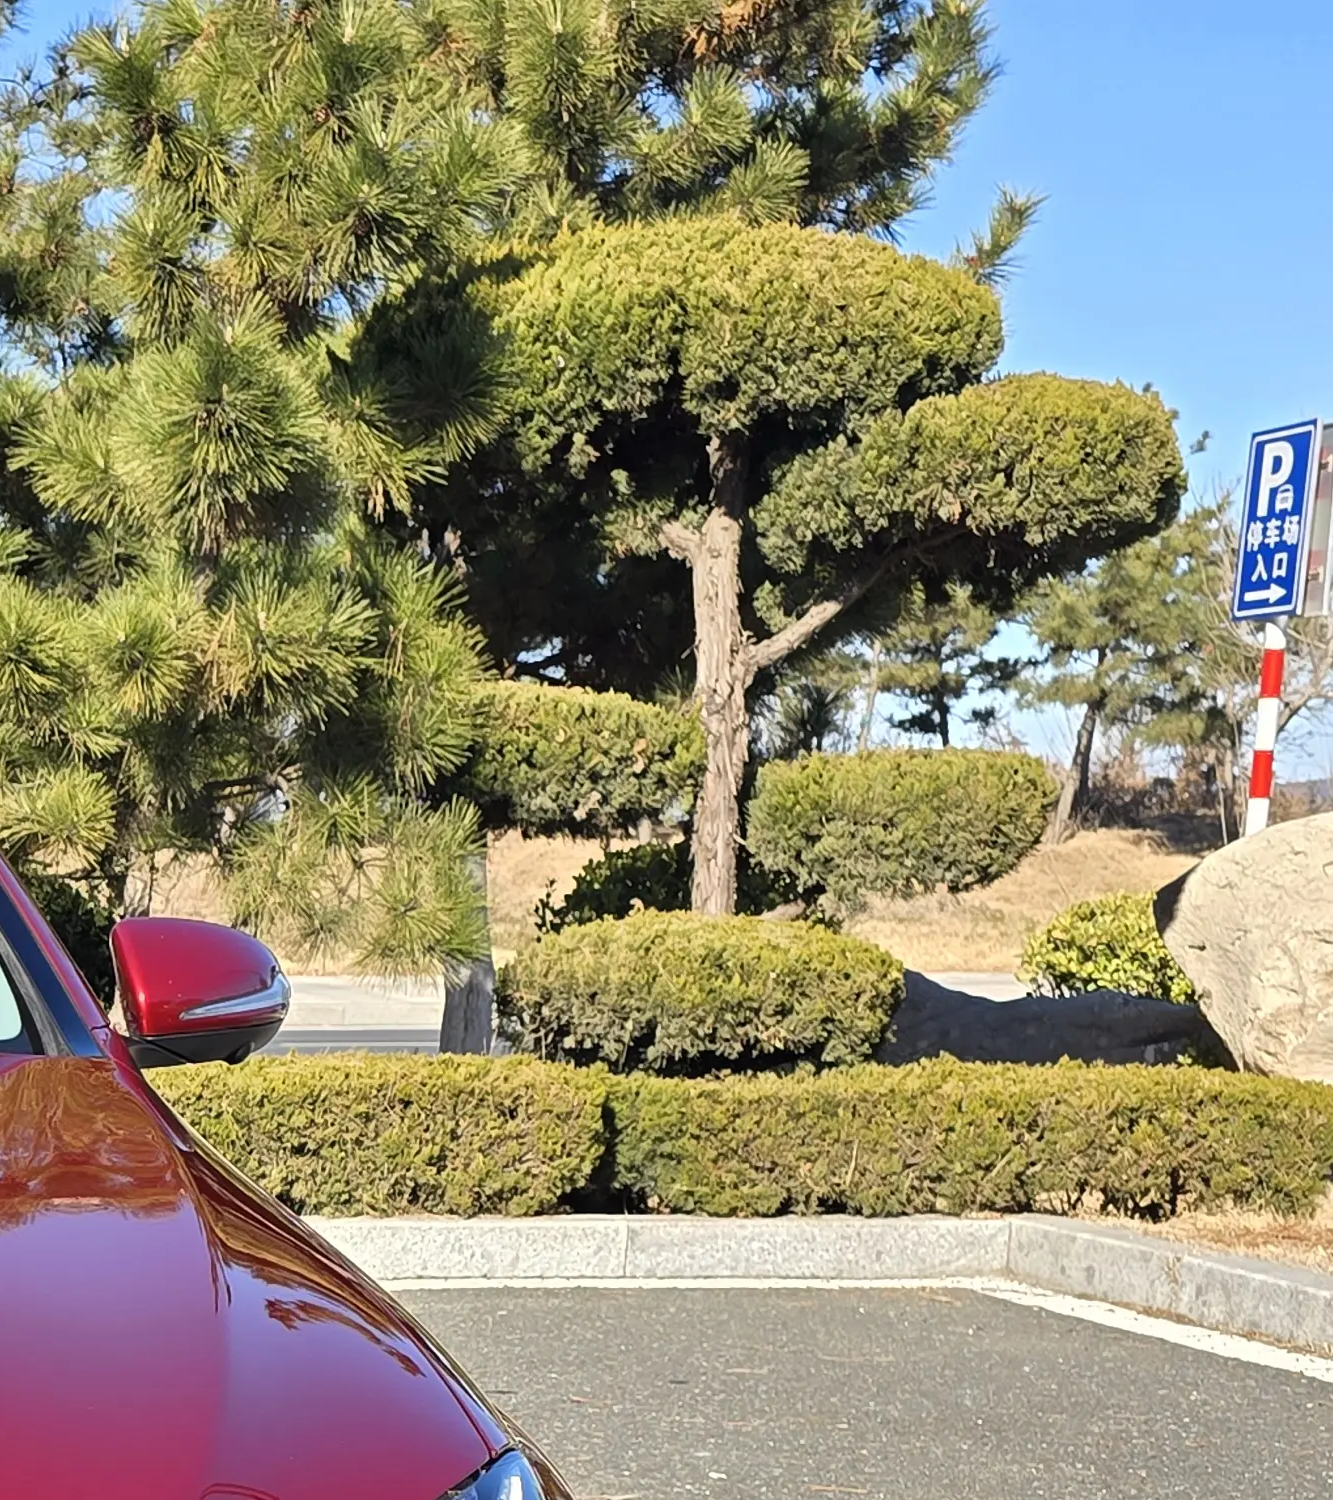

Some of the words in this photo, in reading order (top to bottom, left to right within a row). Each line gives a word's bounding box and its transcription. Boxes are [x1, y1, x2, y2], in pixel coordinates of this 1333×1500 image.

[1257, 441, 1294, 517] P
[1247, 515, 1300, 552] 停车场
[1251, 552, 1288, 582] 入口
